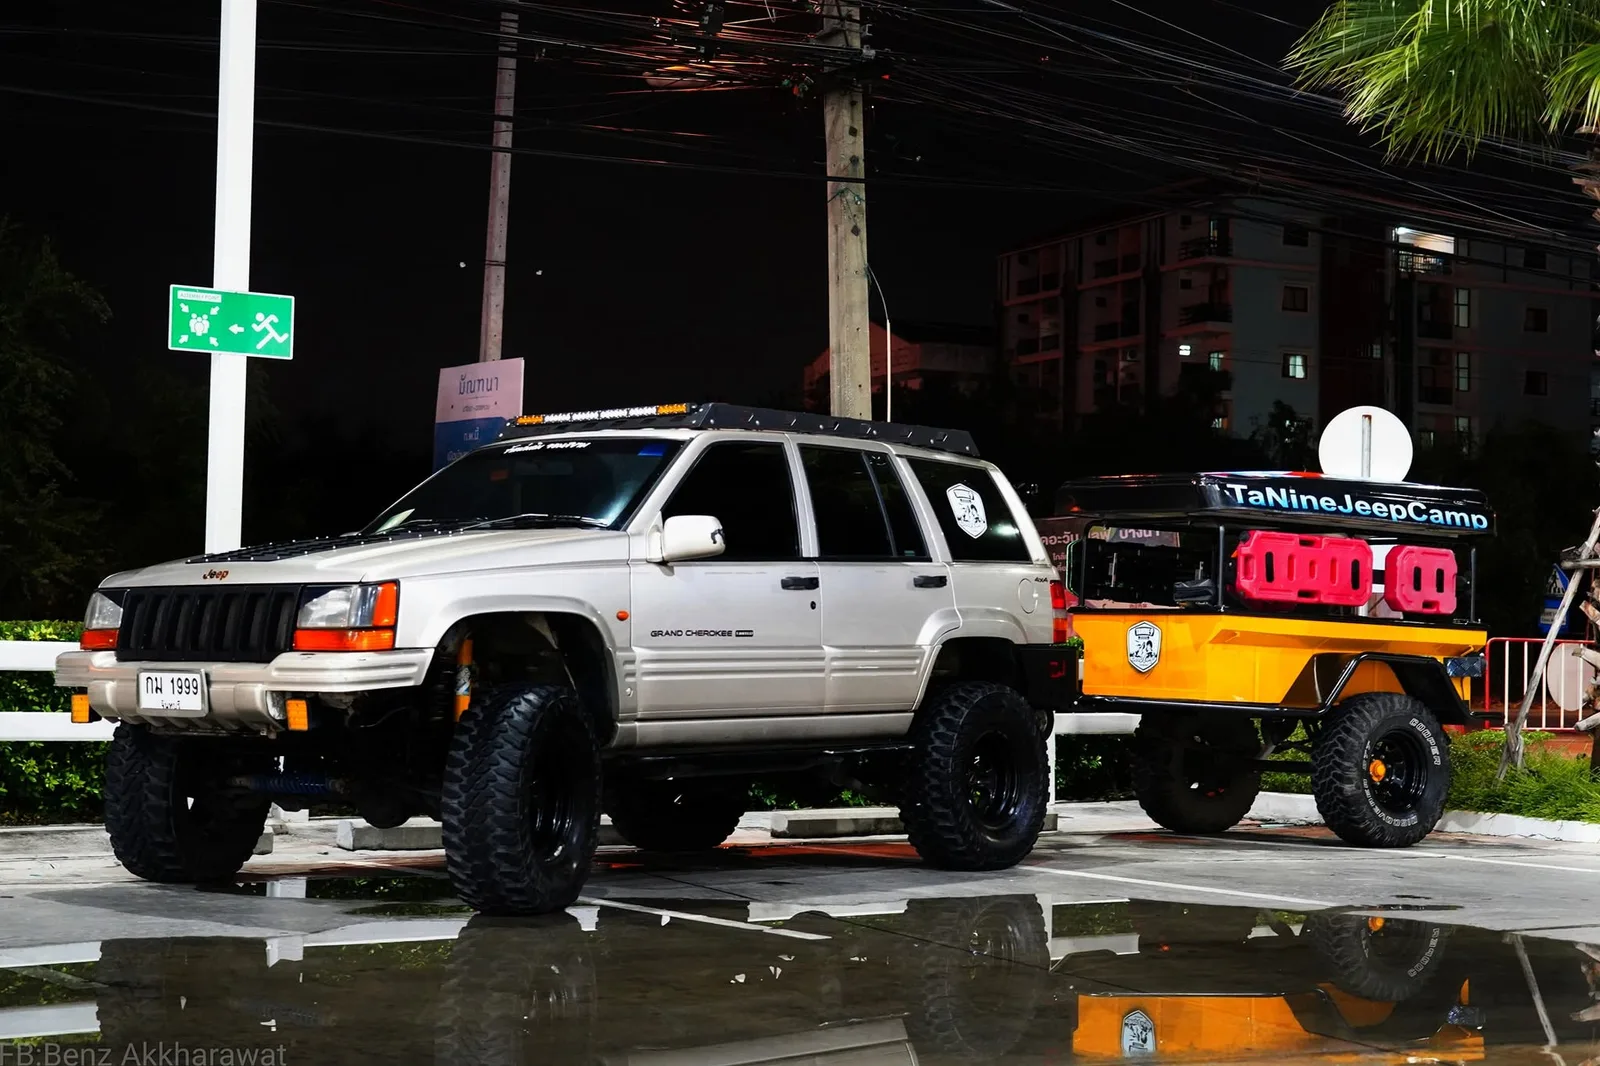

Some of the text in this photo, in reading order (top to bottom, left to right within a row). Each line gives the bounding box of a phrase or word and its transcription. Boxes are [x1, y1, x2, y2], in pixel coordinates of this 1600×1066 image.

[1226, 483, 1488, 530] TaNineJeepCamp
[203, 569, 229, 581] Jeep
[650, 629, 683, 637] GRAND
[685, 629, 733, 637] CHEROKEE
[170, 677, 199, 695] 1999
[1409, 717, 1441, 766] COOPER
